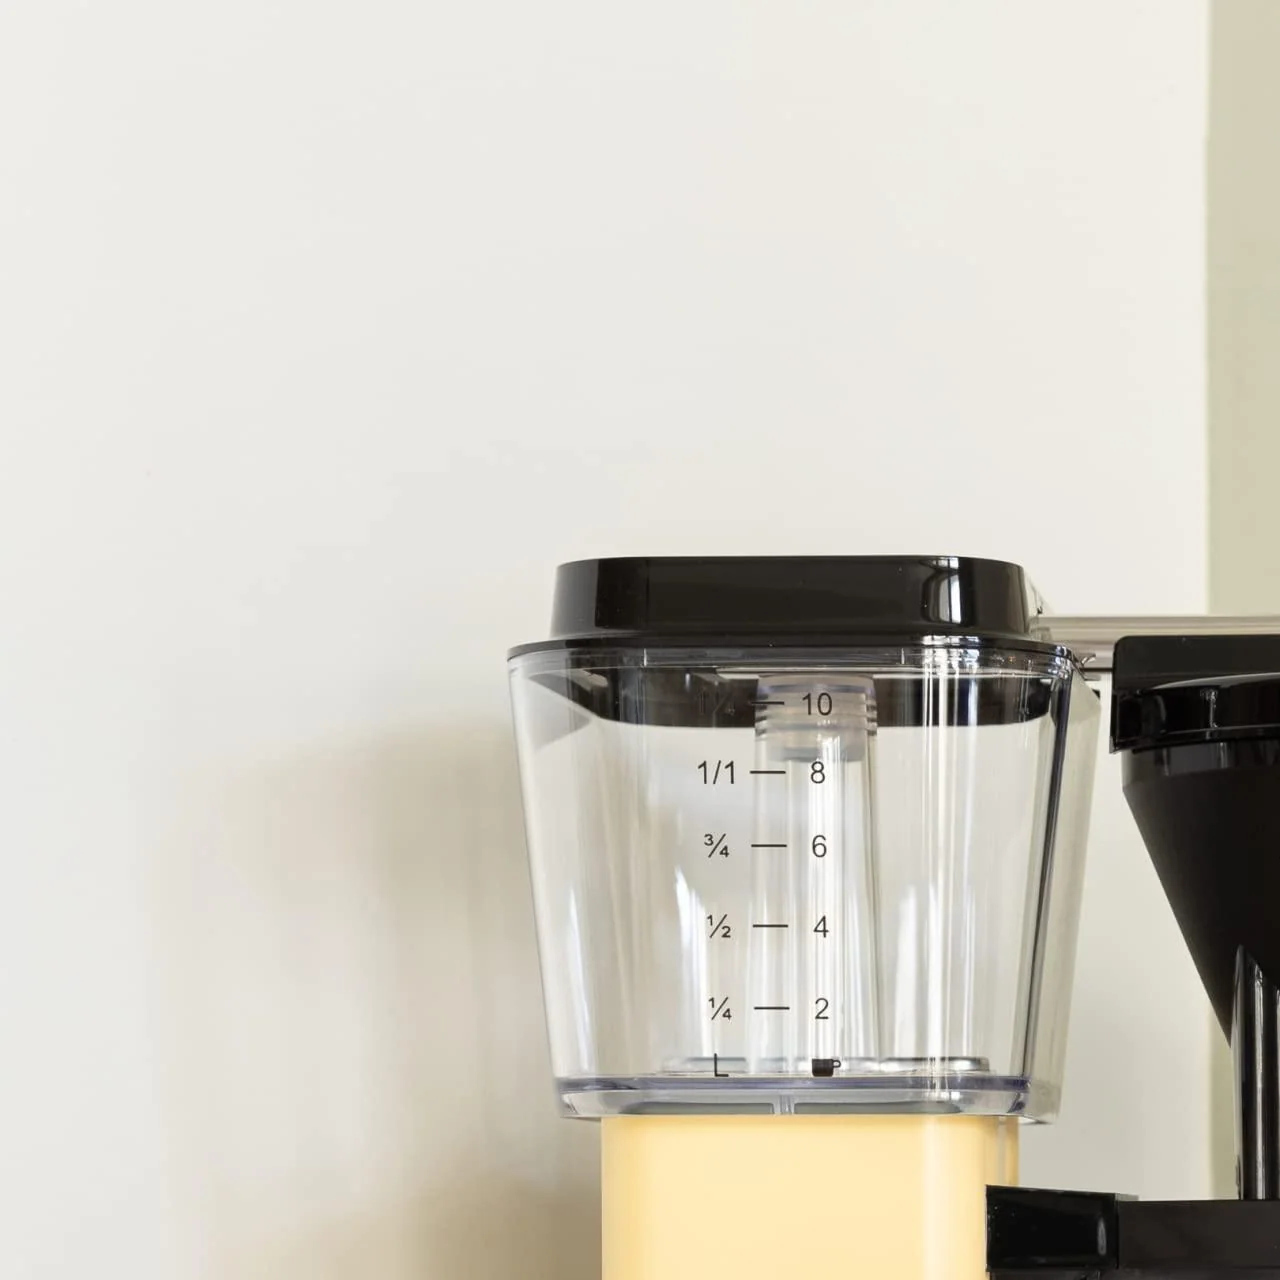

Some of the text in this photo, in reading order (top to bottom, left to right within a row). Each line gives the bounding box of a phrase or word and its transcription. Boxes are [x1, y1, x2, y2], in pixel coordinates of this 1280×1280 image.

[802, 692, 833, 716] 10
[697, 760, 826, 785] 1/1 8
[811, 834, 827, 858] 6
[813, 915, 830, 938] 4
[814, 997, 829, 1020] 2
[713, 1053, 729, 1077] L
